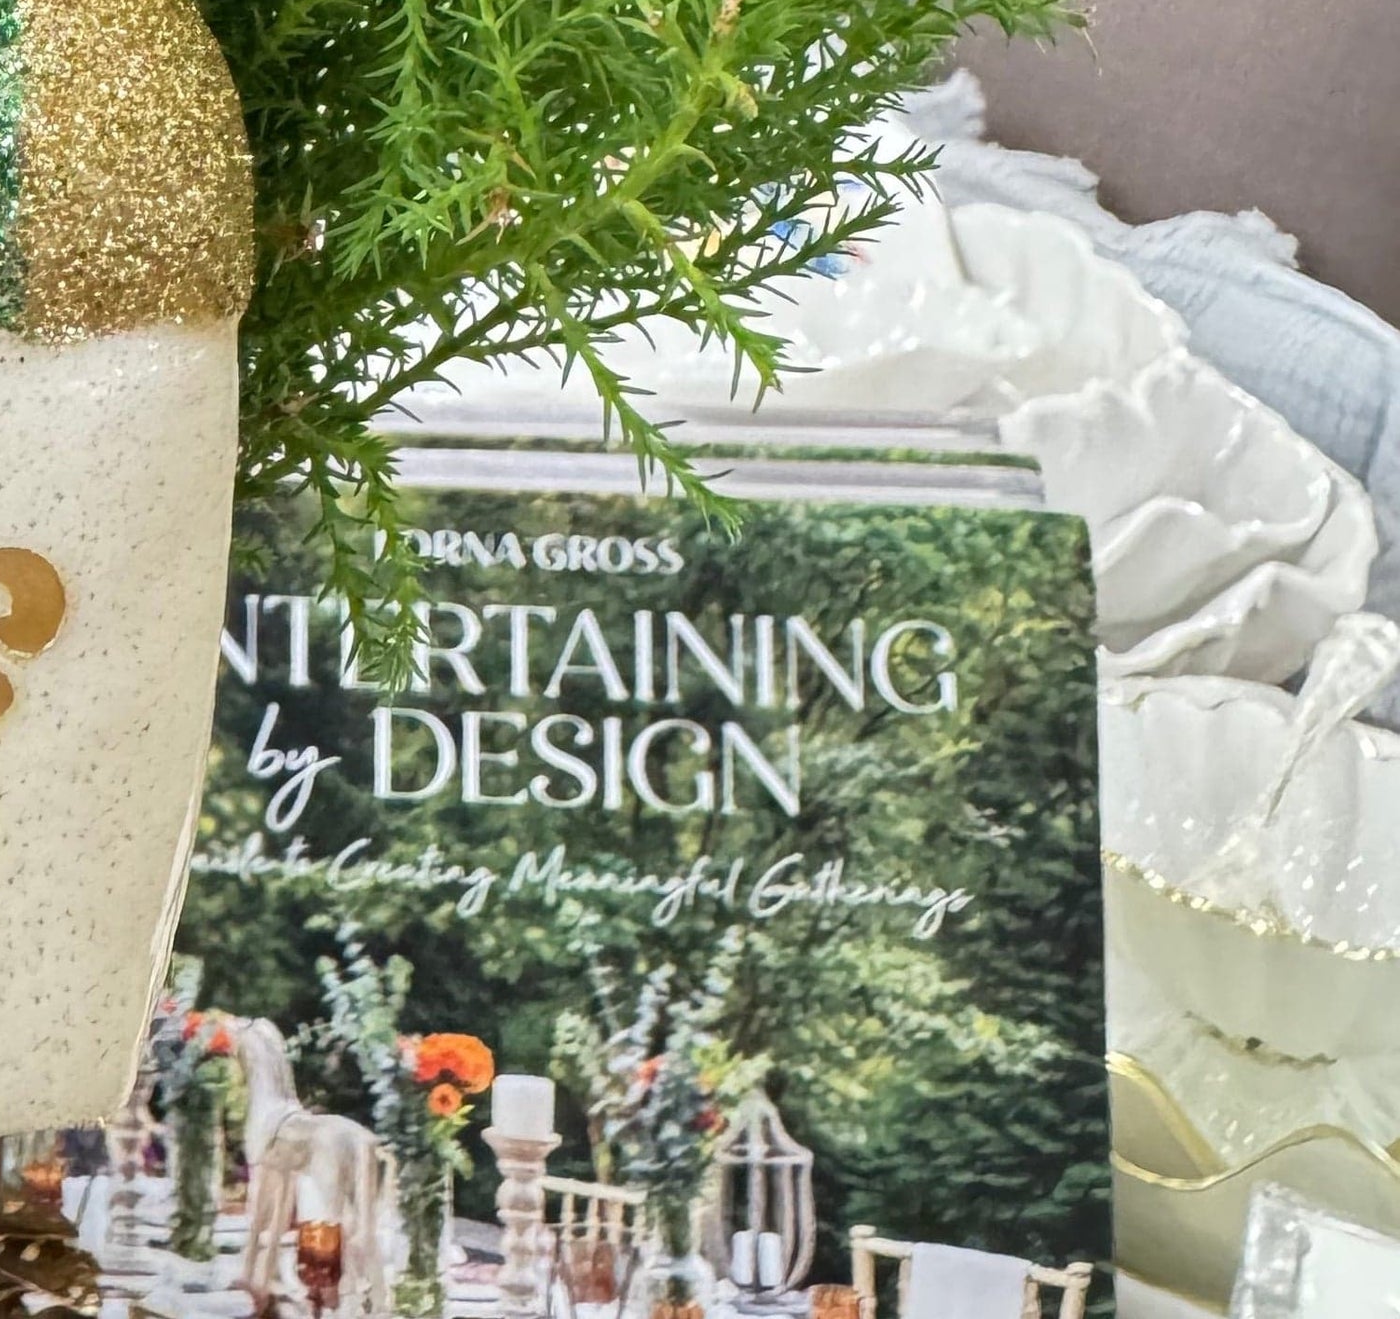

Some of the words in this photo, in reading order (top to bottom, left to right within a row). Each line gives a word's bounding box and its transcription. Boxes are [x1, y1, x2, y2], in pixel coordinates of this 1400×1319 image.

[533, 532, 685, 575] GROSS
[220, 593, 958, 715] NTERTAINING
[246, 701, 342, 833] by
[371, 706, 800, 817] DESIGN
[326, 836, 497, 920] Creating
[508, 843, 744, 928] Meaningful
[748, 851, 976, 941] Gatherings
